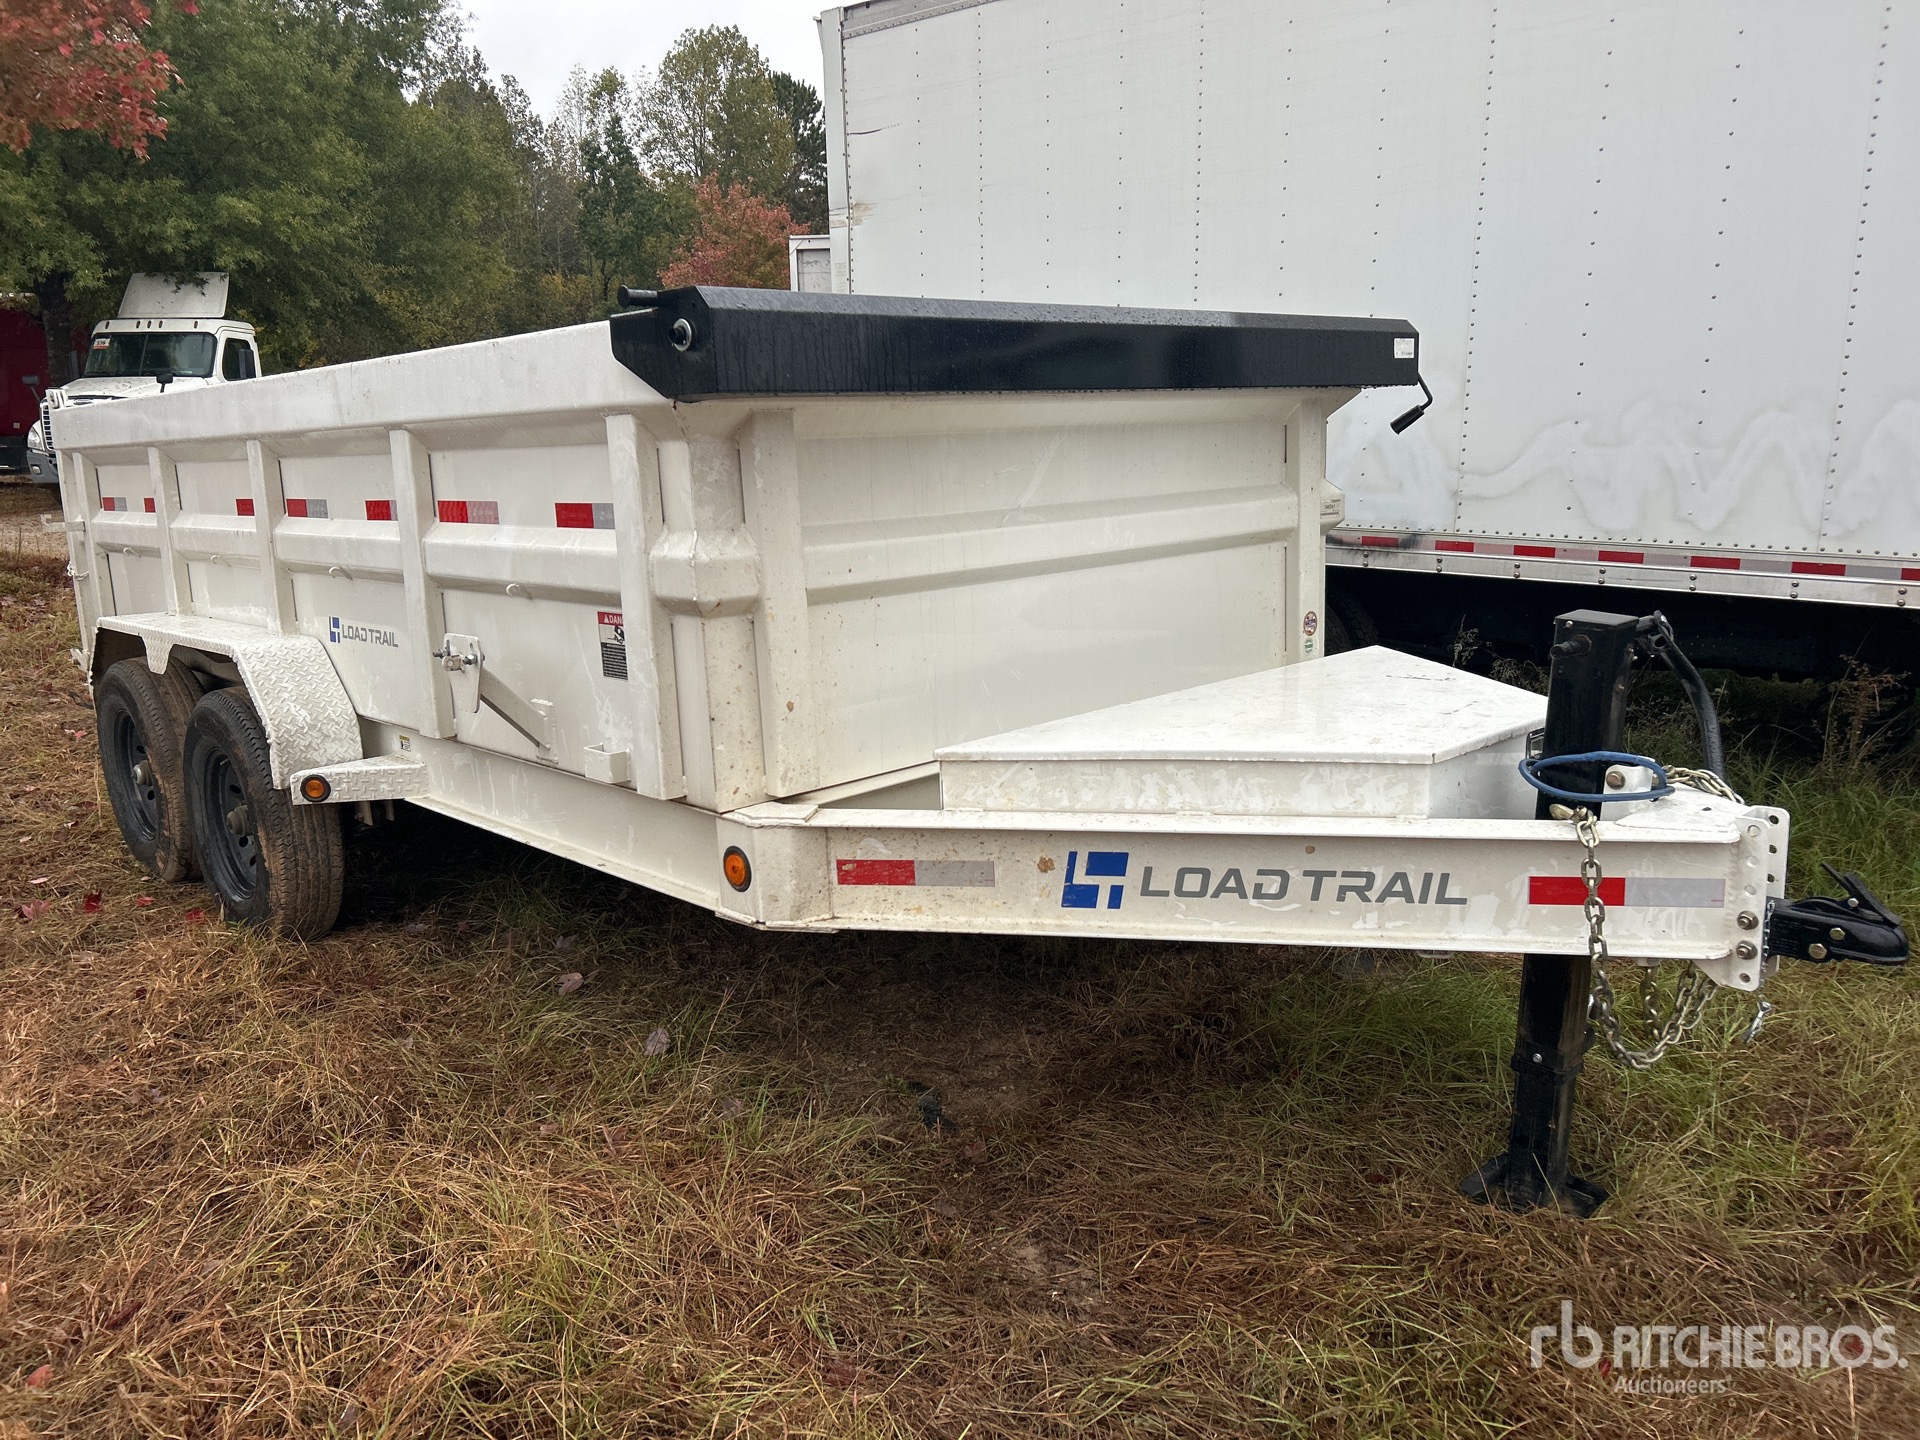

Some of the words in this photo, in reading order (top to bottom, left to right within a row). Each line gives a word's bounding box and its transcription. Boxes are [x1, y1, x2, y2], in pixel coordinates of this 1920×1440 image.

[341, 624, 368, 642] LOAD
[368, 628, 399, 648] TRAIL
[1139, 865, 1291, 901] LOAD
[1302, 869, 1469, 905] TRAIL
